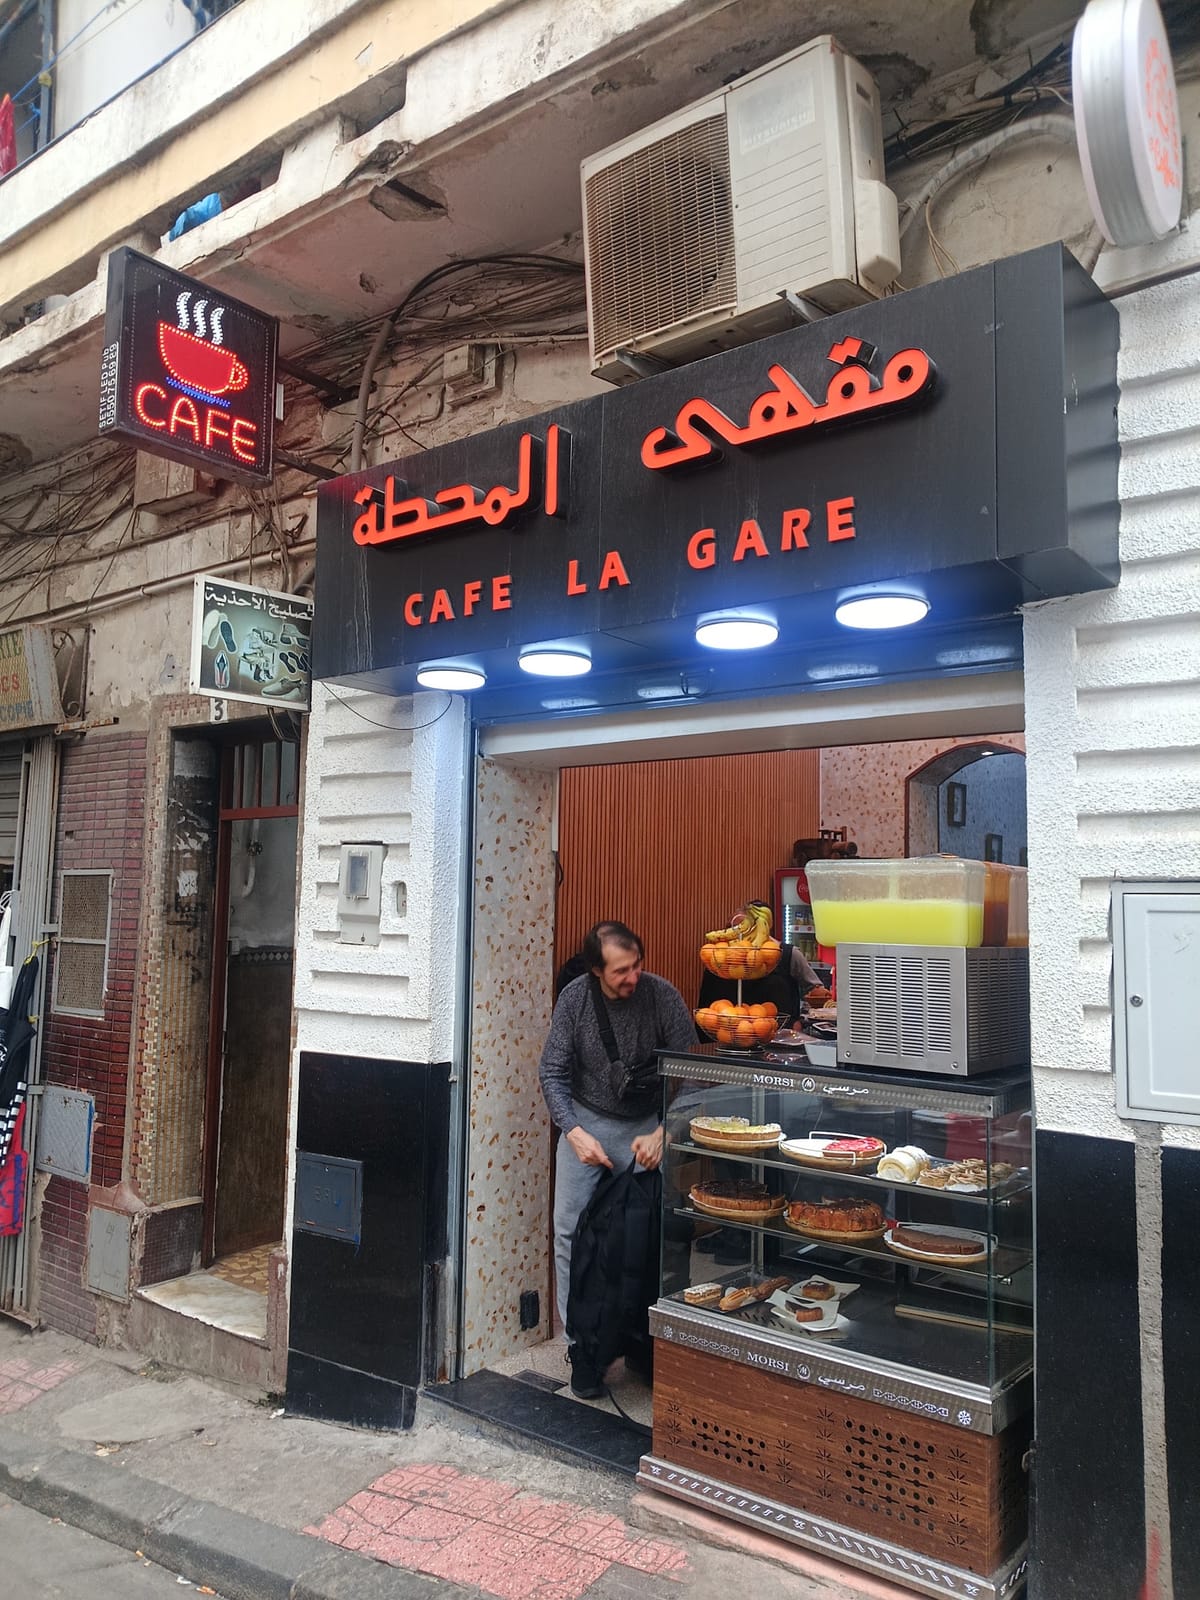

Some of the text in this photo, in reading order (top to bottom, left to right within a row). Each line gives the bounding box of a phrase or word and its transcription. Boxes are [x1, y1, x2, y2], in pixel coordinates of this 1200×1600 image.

[136, 383, 257, 461] CAFE
[353, 336, 931, 546] مقهى المحطة
[404, 496, 857, 627] CAFE LA GARE
[205, 586, 266, 611] الأحذية
[214, 699, 224, 721] 3
[752, 1073, 794, 1087] MORSI
[822, 1085, 869, 1096] مرسي
[746, 1351, 790, 1371] MORSI
[817, 1375, 866, 1391] مرسي
